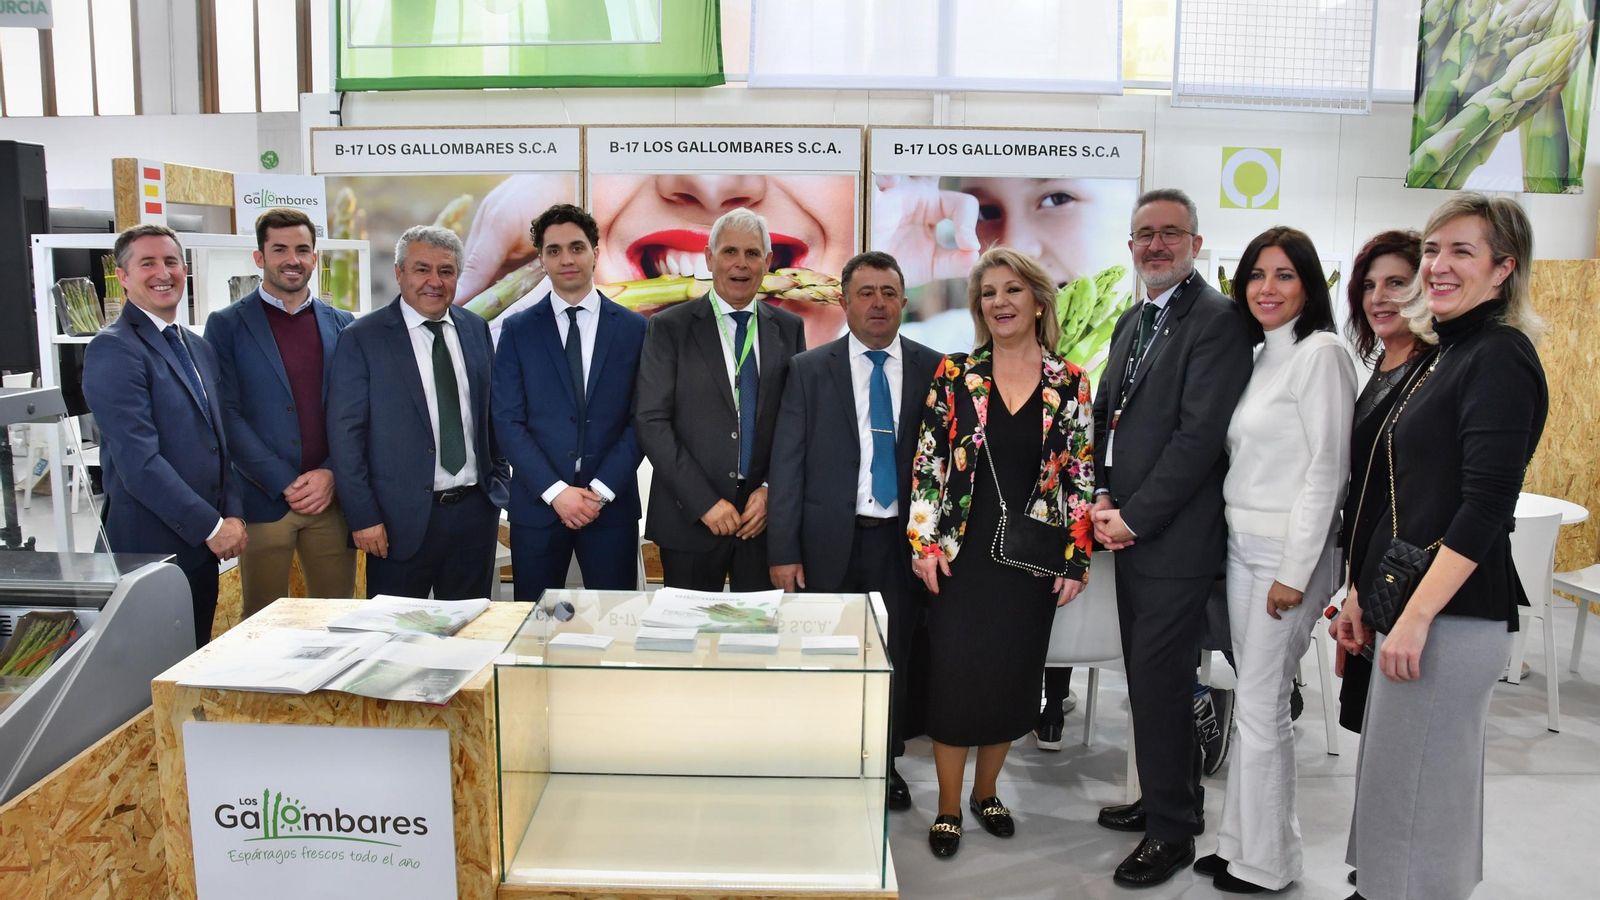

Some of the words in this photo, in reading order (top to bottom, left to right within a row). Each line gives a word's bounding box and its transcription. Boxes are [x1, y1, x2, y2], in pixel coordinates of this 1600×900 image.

[335, 144, 364, 156] B-17
[367, 143, 397, 156] LOS
[400, 142, 514, 155] GALLOMBARES
[518, 142, 557, 154] S.C.A
[609, 141, 640, 153] B-17
[643, 141, 673, 153] LOS
[677, 141, 794, 154] GALLOMBARES
[797, 141, 842, 154] S.C.A.
[894, 143, 924, 155] B-17
[928, 143, 958, 156] LOS
[962, 143, 1078, 157] GALLOMBARES
[1081, 145, 1120, 158] S.C.A
[239, 797, 258, 806] LOS
[214, 788, 428, 839] Gallombares
[227, 848, 297, 866] Espárragos
[302, 846, 345, 861] frescos
[350, 850, 378, 864] todo
[382, 852, 394, 866] el
